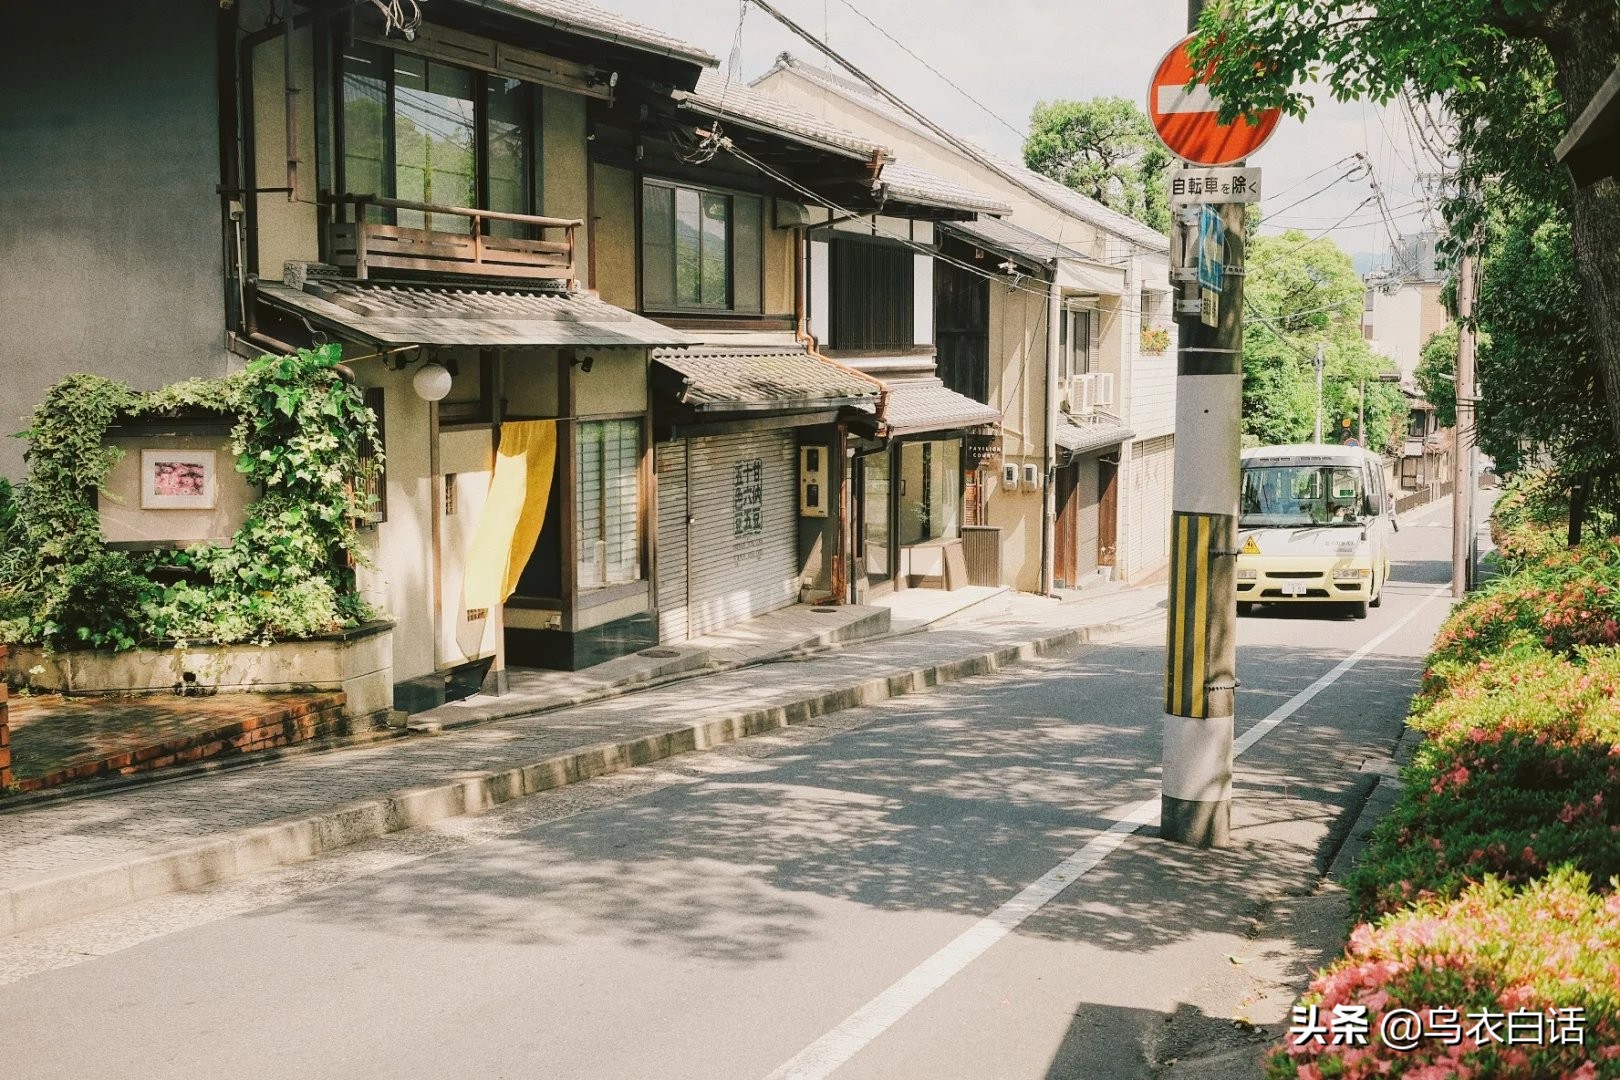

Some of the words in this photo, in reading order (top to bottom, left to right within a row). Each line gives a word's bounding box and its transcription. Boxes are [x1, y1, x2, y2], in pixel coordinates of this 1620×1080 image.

[1172, 175, 1257, 195] 自転車を除く
